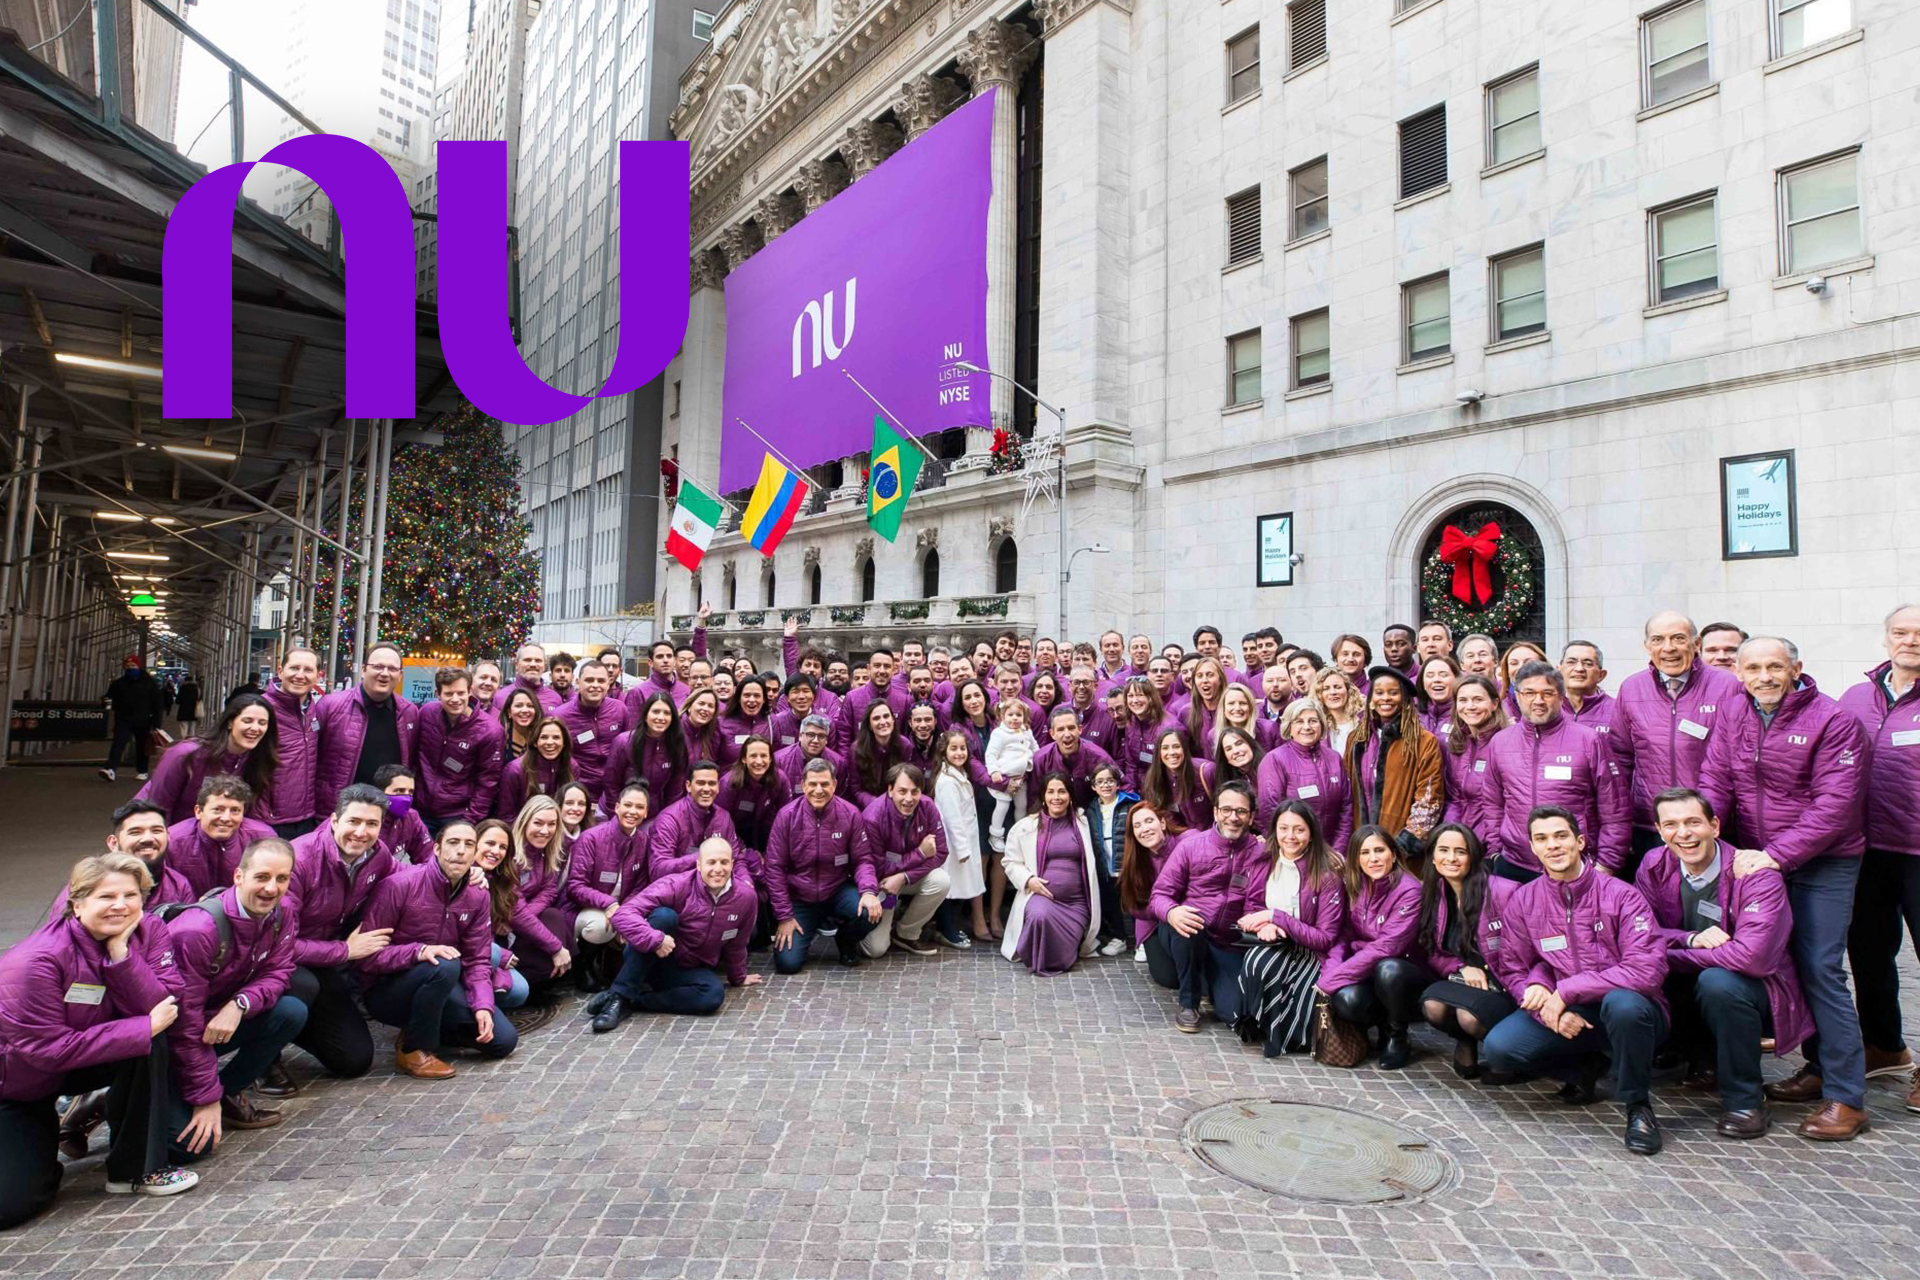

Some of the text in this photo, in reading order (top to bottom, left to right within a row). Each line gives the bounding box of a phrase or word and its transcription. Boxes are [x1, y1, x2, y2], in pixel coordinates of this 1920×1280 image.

[944, 342, 962, 360] NU
[939, 367, 970, 382] LISTED
[940, 386, 970, 405] NYSE
[1737, 503, 1770, 511] Happy
[1737, 510, 1782, 520] Holidays
[11, 710, 104, 719] Broad St Station
